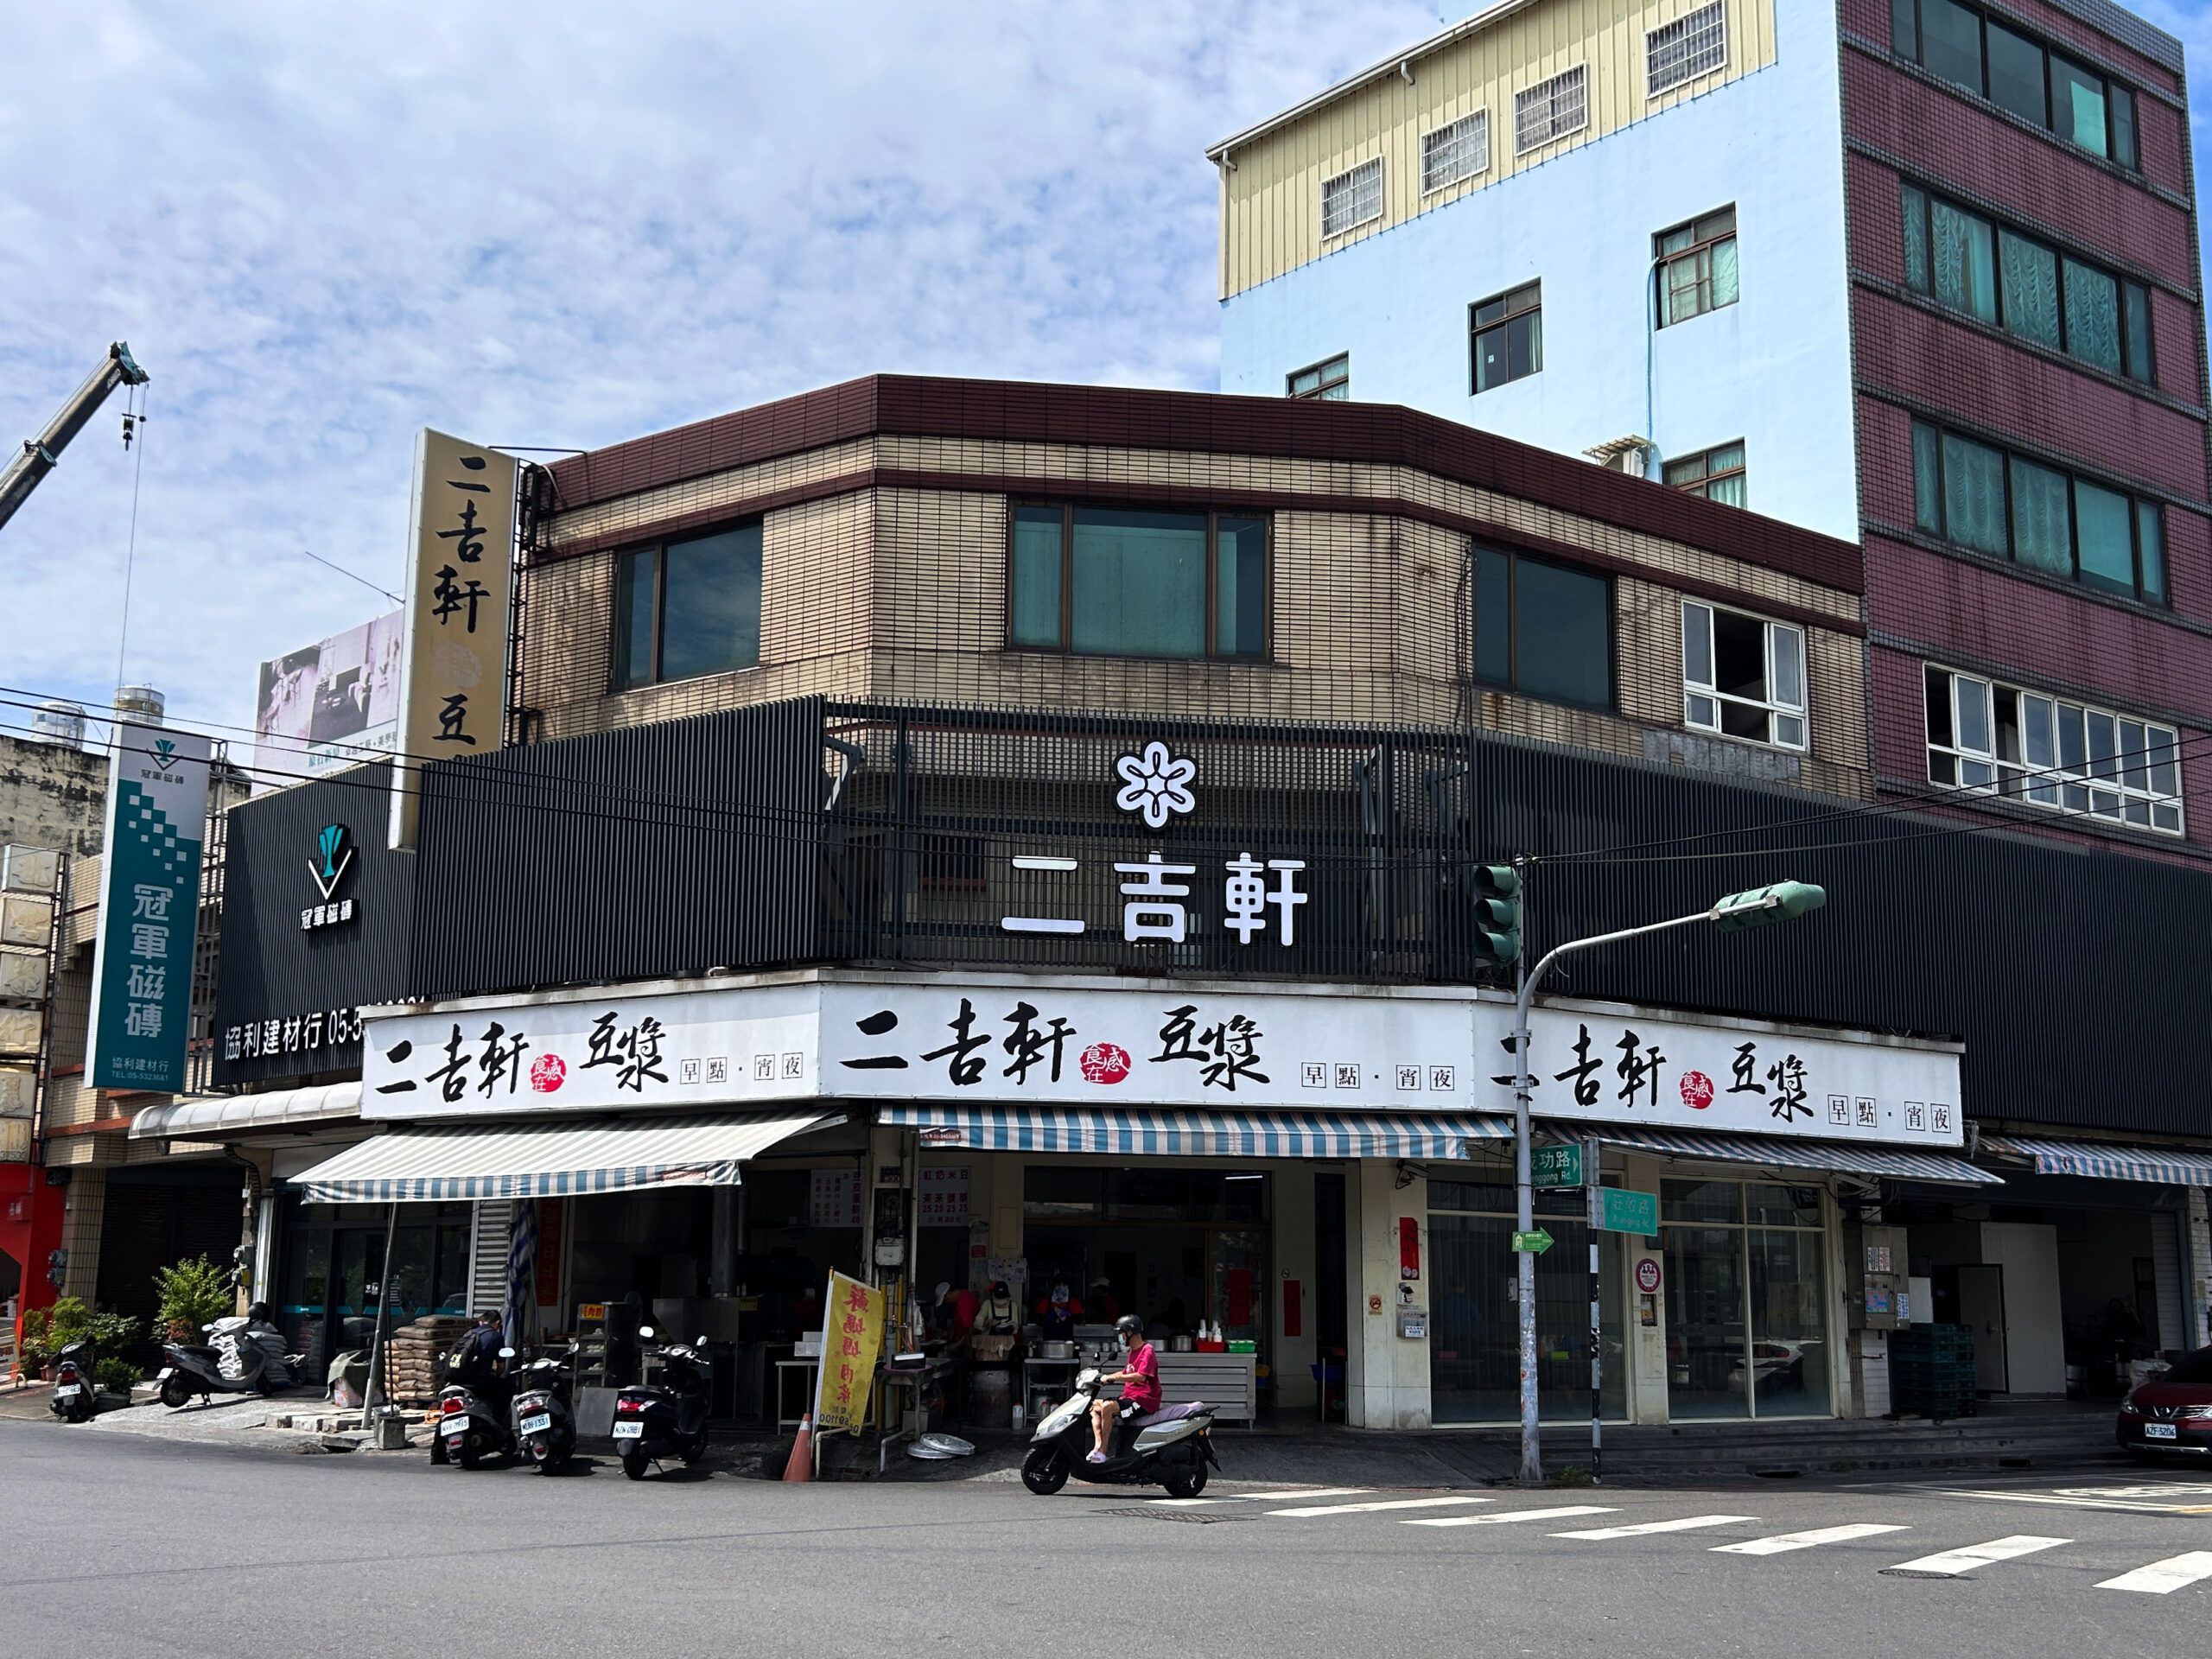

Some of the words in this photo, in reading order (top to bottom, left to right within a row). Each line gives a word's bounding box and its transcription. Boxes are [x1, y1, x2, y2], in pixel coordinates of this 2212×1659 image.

[433, 456, 491, 633] 二吉軒
[432, 693, 476, 759] 豆
[141, 769, 184, 785] 冠軍磁磚
[300, 899, 353, 930] 冠軍磁磚
[1001, 851, 1307, 946] 二吉軒
[124, 884, 173, 1039] 冠軍磁磚
[112, 1057, 169, 1072] 協利建材行
[225, 1012, 321, 1062] 協利建材行
[375, 1021, 530, 1103] 二吉軒
[579, 1011, 669, 1092] 豆漿
[839, 997, 1076, 1086] 二吉軒
[1148, 1004, 1270, 1092] 豆漿
[1491, 1023, 1667, 1107] 二吉軒
[1726, 1041, 1814, 1122] 豆漿
